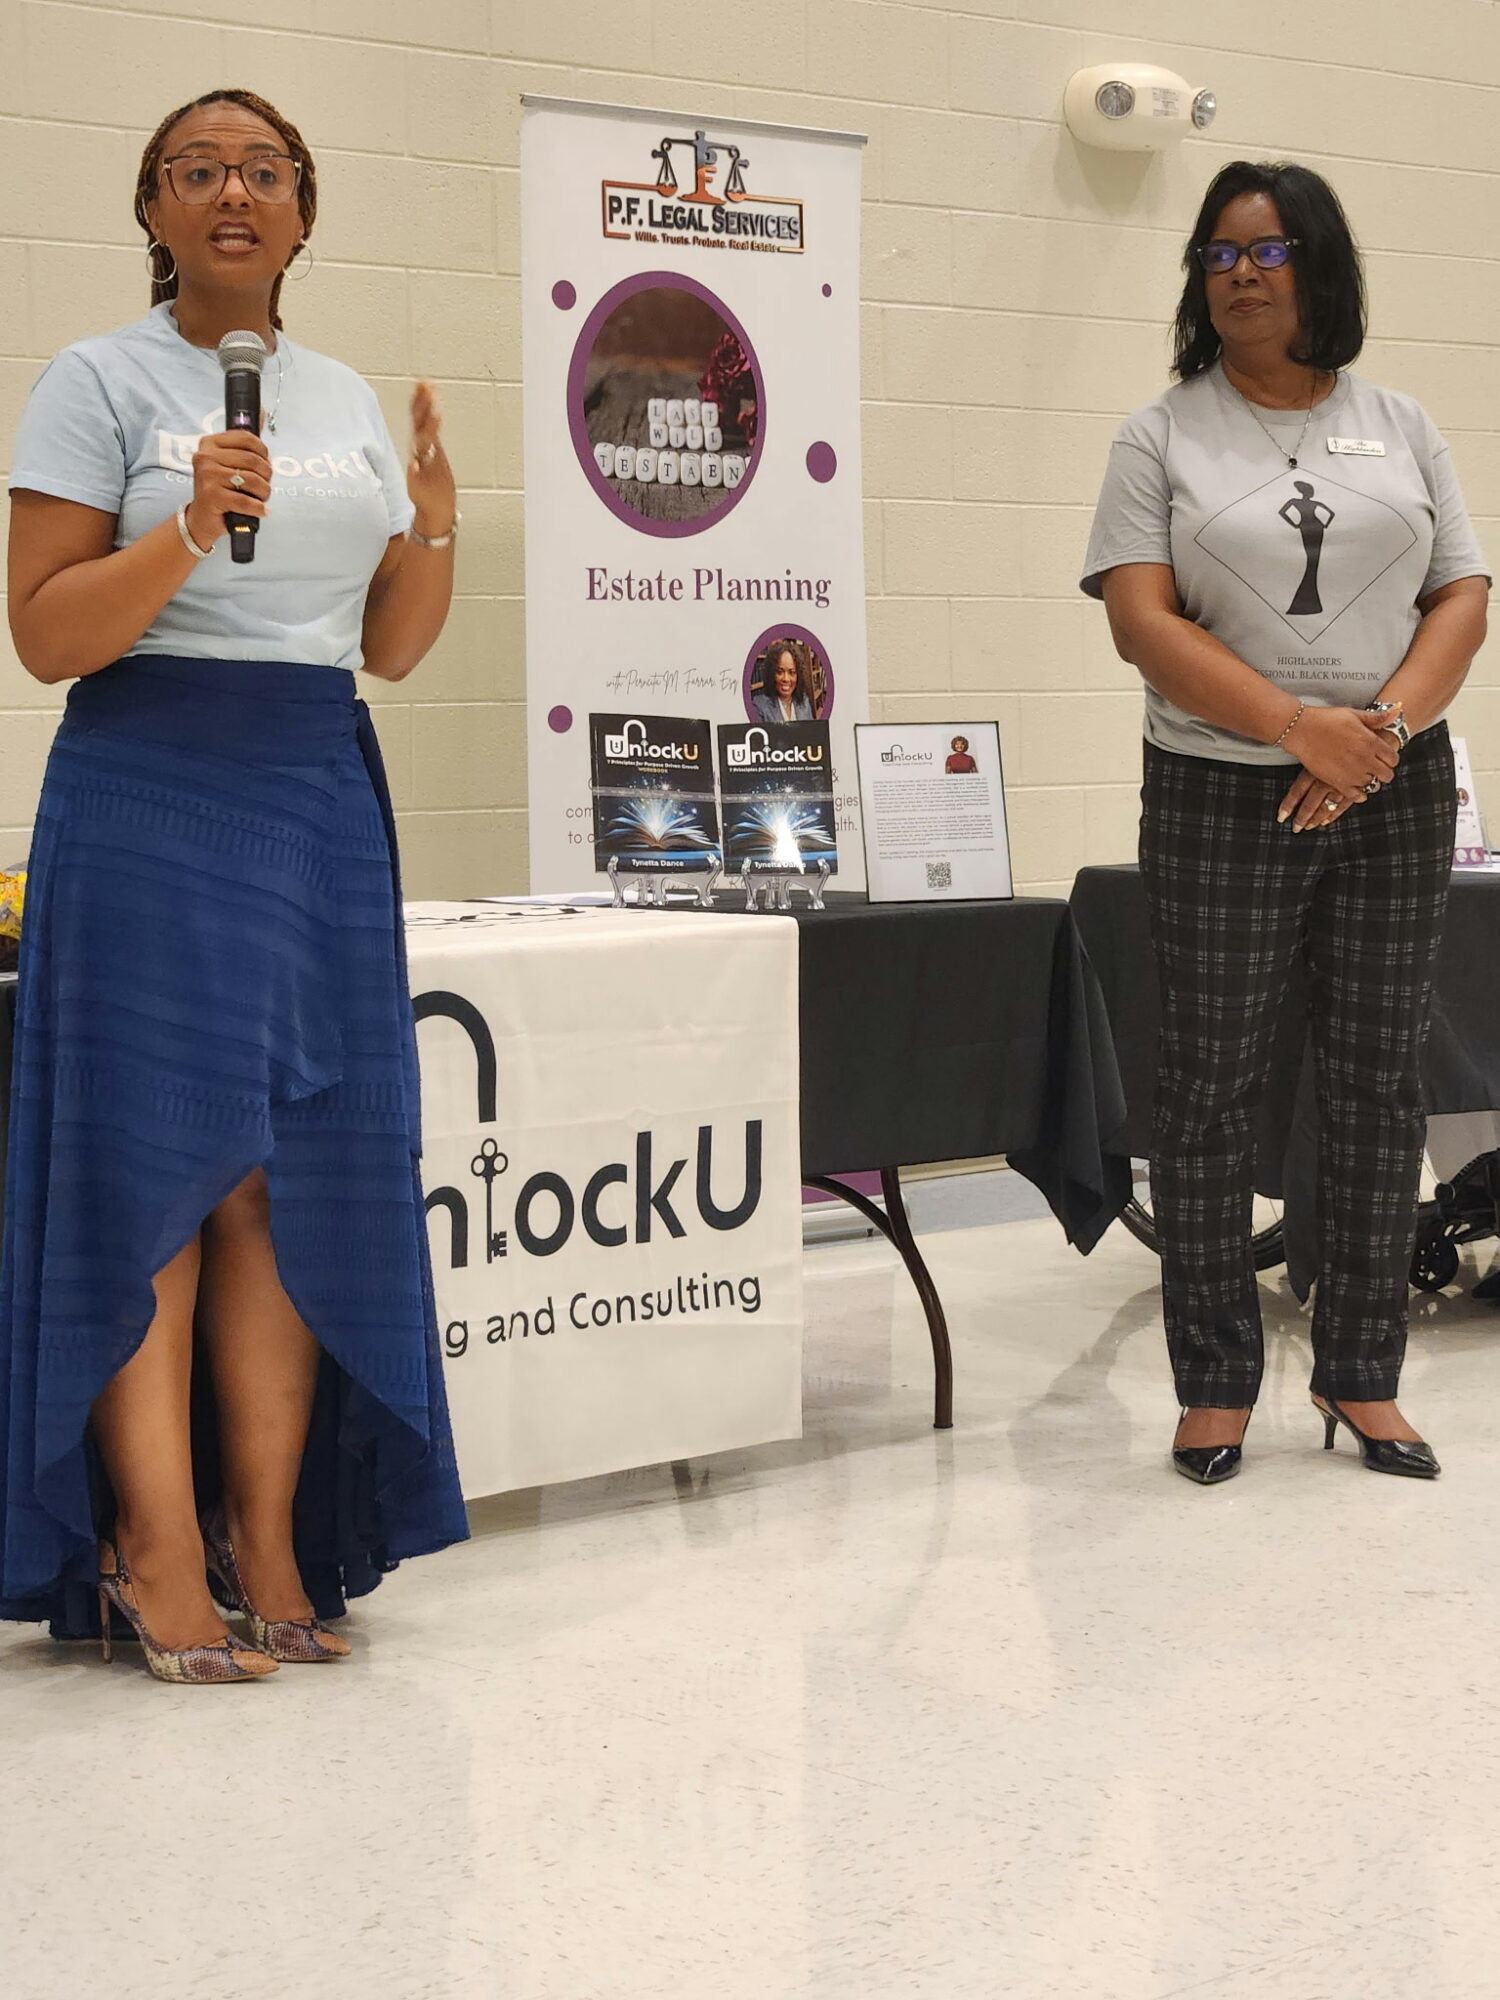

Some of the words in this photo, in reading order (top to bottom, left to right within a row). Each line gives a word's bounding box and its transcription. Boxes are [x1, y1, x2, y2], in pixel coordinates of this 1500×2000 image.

[608, 195, 644, 226] P.F.
[654, 405, 713, 422] LAST
[653, 429, 718, 444] WILL
[273, 485, 298, 497] nd
[585, 567, 684, 601] Estate
[692, 567, 832, 608] Planning
[1277, 656, 1342, 666] HIGHLANDERS
[1299, 670, 1329, 680] BLACK
[1331, 671, 1366, 681] WOMEN
[834, 793, 859, 812] gies
[568, 831, 582, 844] to
[660, 859, 684, 867] Dance
[425, 1119, 763, 1269] nlockU
[486, 1296, 556, 1344] and
[569, 1272, 762, 1329] Consulting
